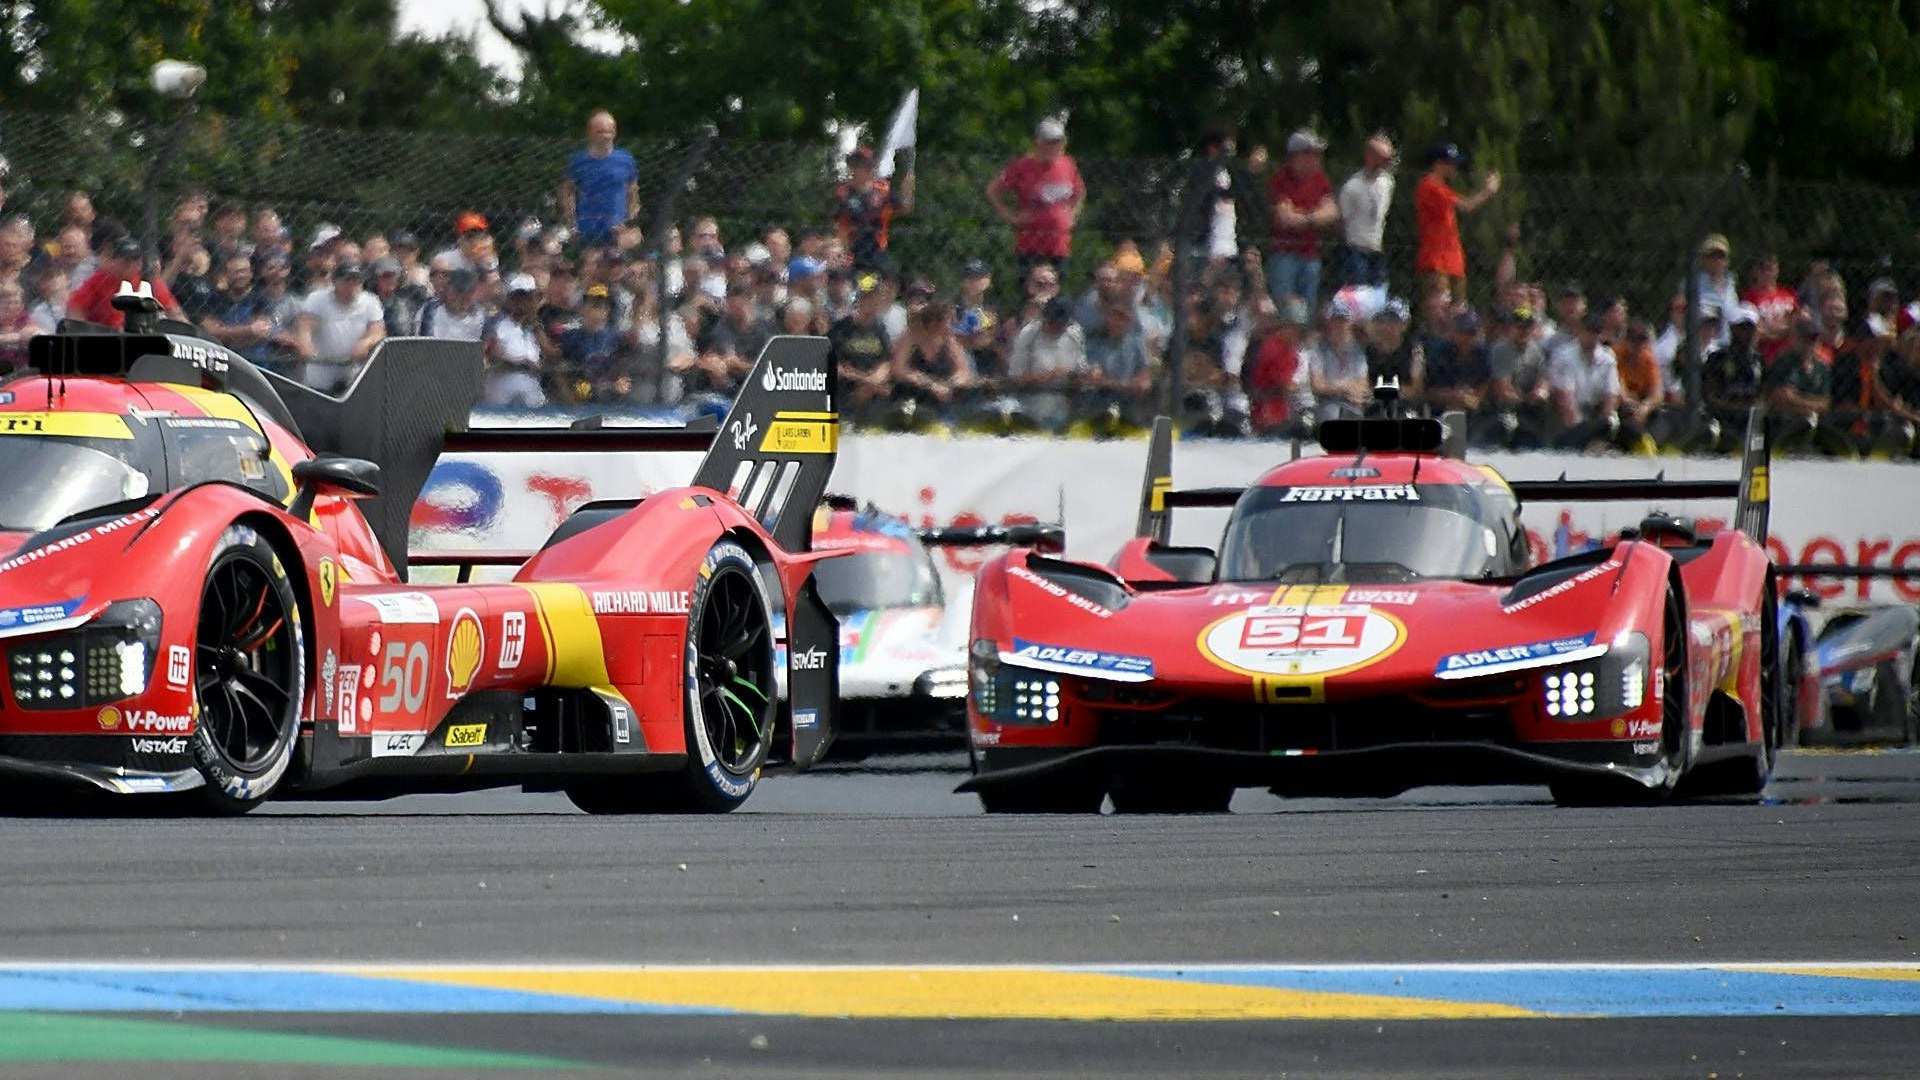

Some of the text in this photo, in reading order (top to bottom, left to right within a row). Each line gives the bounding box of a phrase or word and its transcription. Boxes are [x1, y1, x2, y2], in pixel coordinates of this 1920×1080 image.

[776, 367, 828, 391] Santander
[1280, 485, 1420, 502] Ferrari
[1007, 566, 1113, 619] RICHARD MILLE
[1503, 559, 1622, 615] RICHARD MILLE
[593, 591, 690, 613] RICHARD MILLE
[1245, 617, 1357, 645] 51
[1015, 645, 1099, 665] ADLER
[1446, 645, 1531, 669] ADLER
[379, 641, 429, 715] 50
[125, 710, 191, 731] V-Power
[132, 736, 188, 753] VISTAJET
[451, 727, 483, 745] Sabelt
